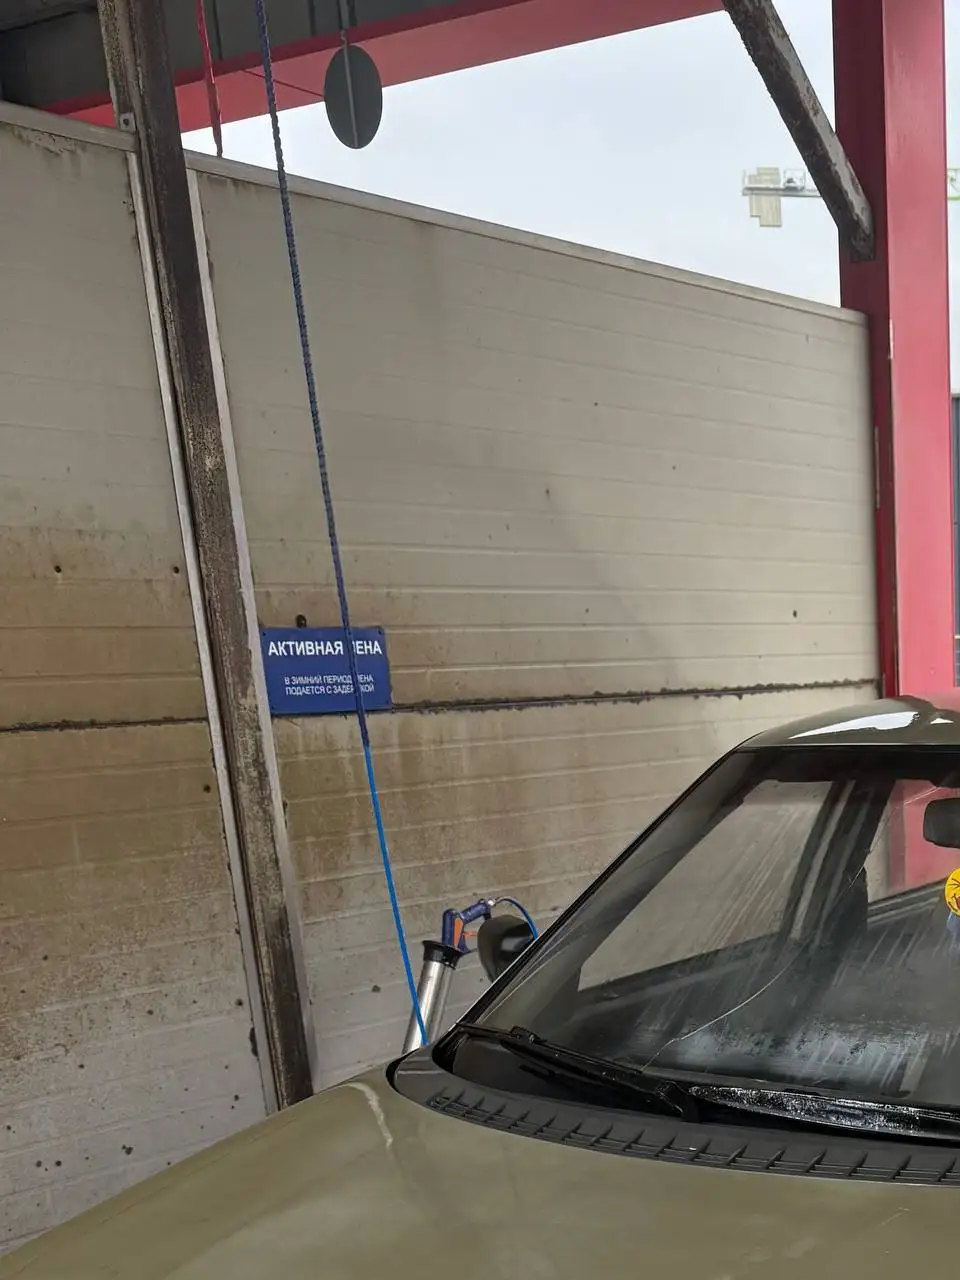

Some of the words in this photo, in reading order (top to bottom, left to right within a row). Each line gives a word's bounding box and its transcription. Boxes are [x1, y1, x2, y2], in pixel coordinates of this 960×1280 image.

[268, 640, 344, 656] АКТИВНАЯ
[285, 676, 290, 685] В
[291, 674, 322, 685] ЗИМНИЙ
[323, 674, 352, 685] ПЕРИОД
[285, 686, 325, 695] ПОДАЕТСЯ
[326, 686, 332, 694] С
[333, 684, 374, 694] ЗАДЕРКОЙ
